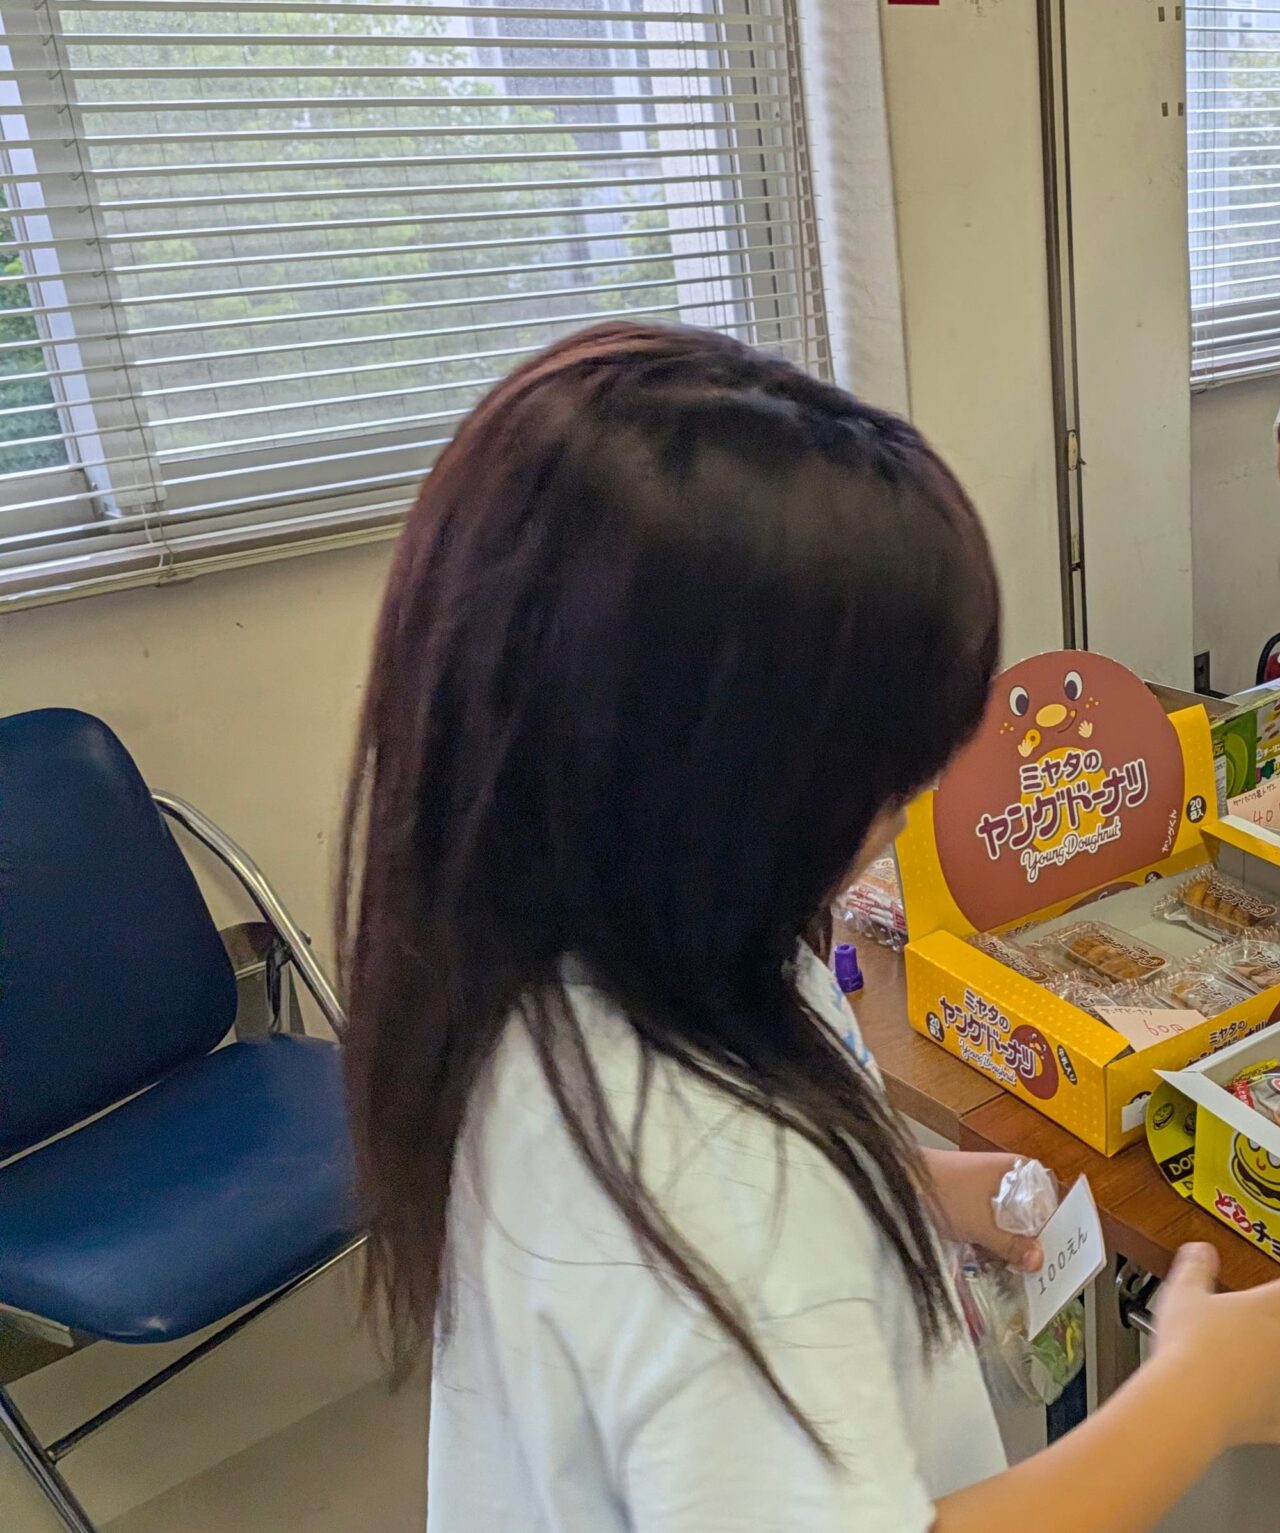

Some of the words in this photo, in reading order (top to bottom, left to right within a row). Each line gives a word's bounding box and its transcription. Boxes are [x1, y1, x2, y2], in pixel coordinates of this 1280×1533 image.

[1019, 749, 1102, 792] ミヤタの
[976, 758, 1149, 860] ヤングドーナツ
[1189, 797, 1203, 810] 20
[1020, 847, 1066, 883] Young
[1064, 815, 1121, 858] Doughnut
[1161, 808, 1178, 854] ヤングくん
[928, 1013, 940, 1029] 20
[964, 988, 1011, 1034] ミヤタの
[1143, 1019, 1185, 1036] 60円
[1208, 1018, 1248, 1046] ミヤタの
[938, 995, 1036, 1079] ヤングドーナツ
[1038, 1226, 1089, 1296] 100えん
